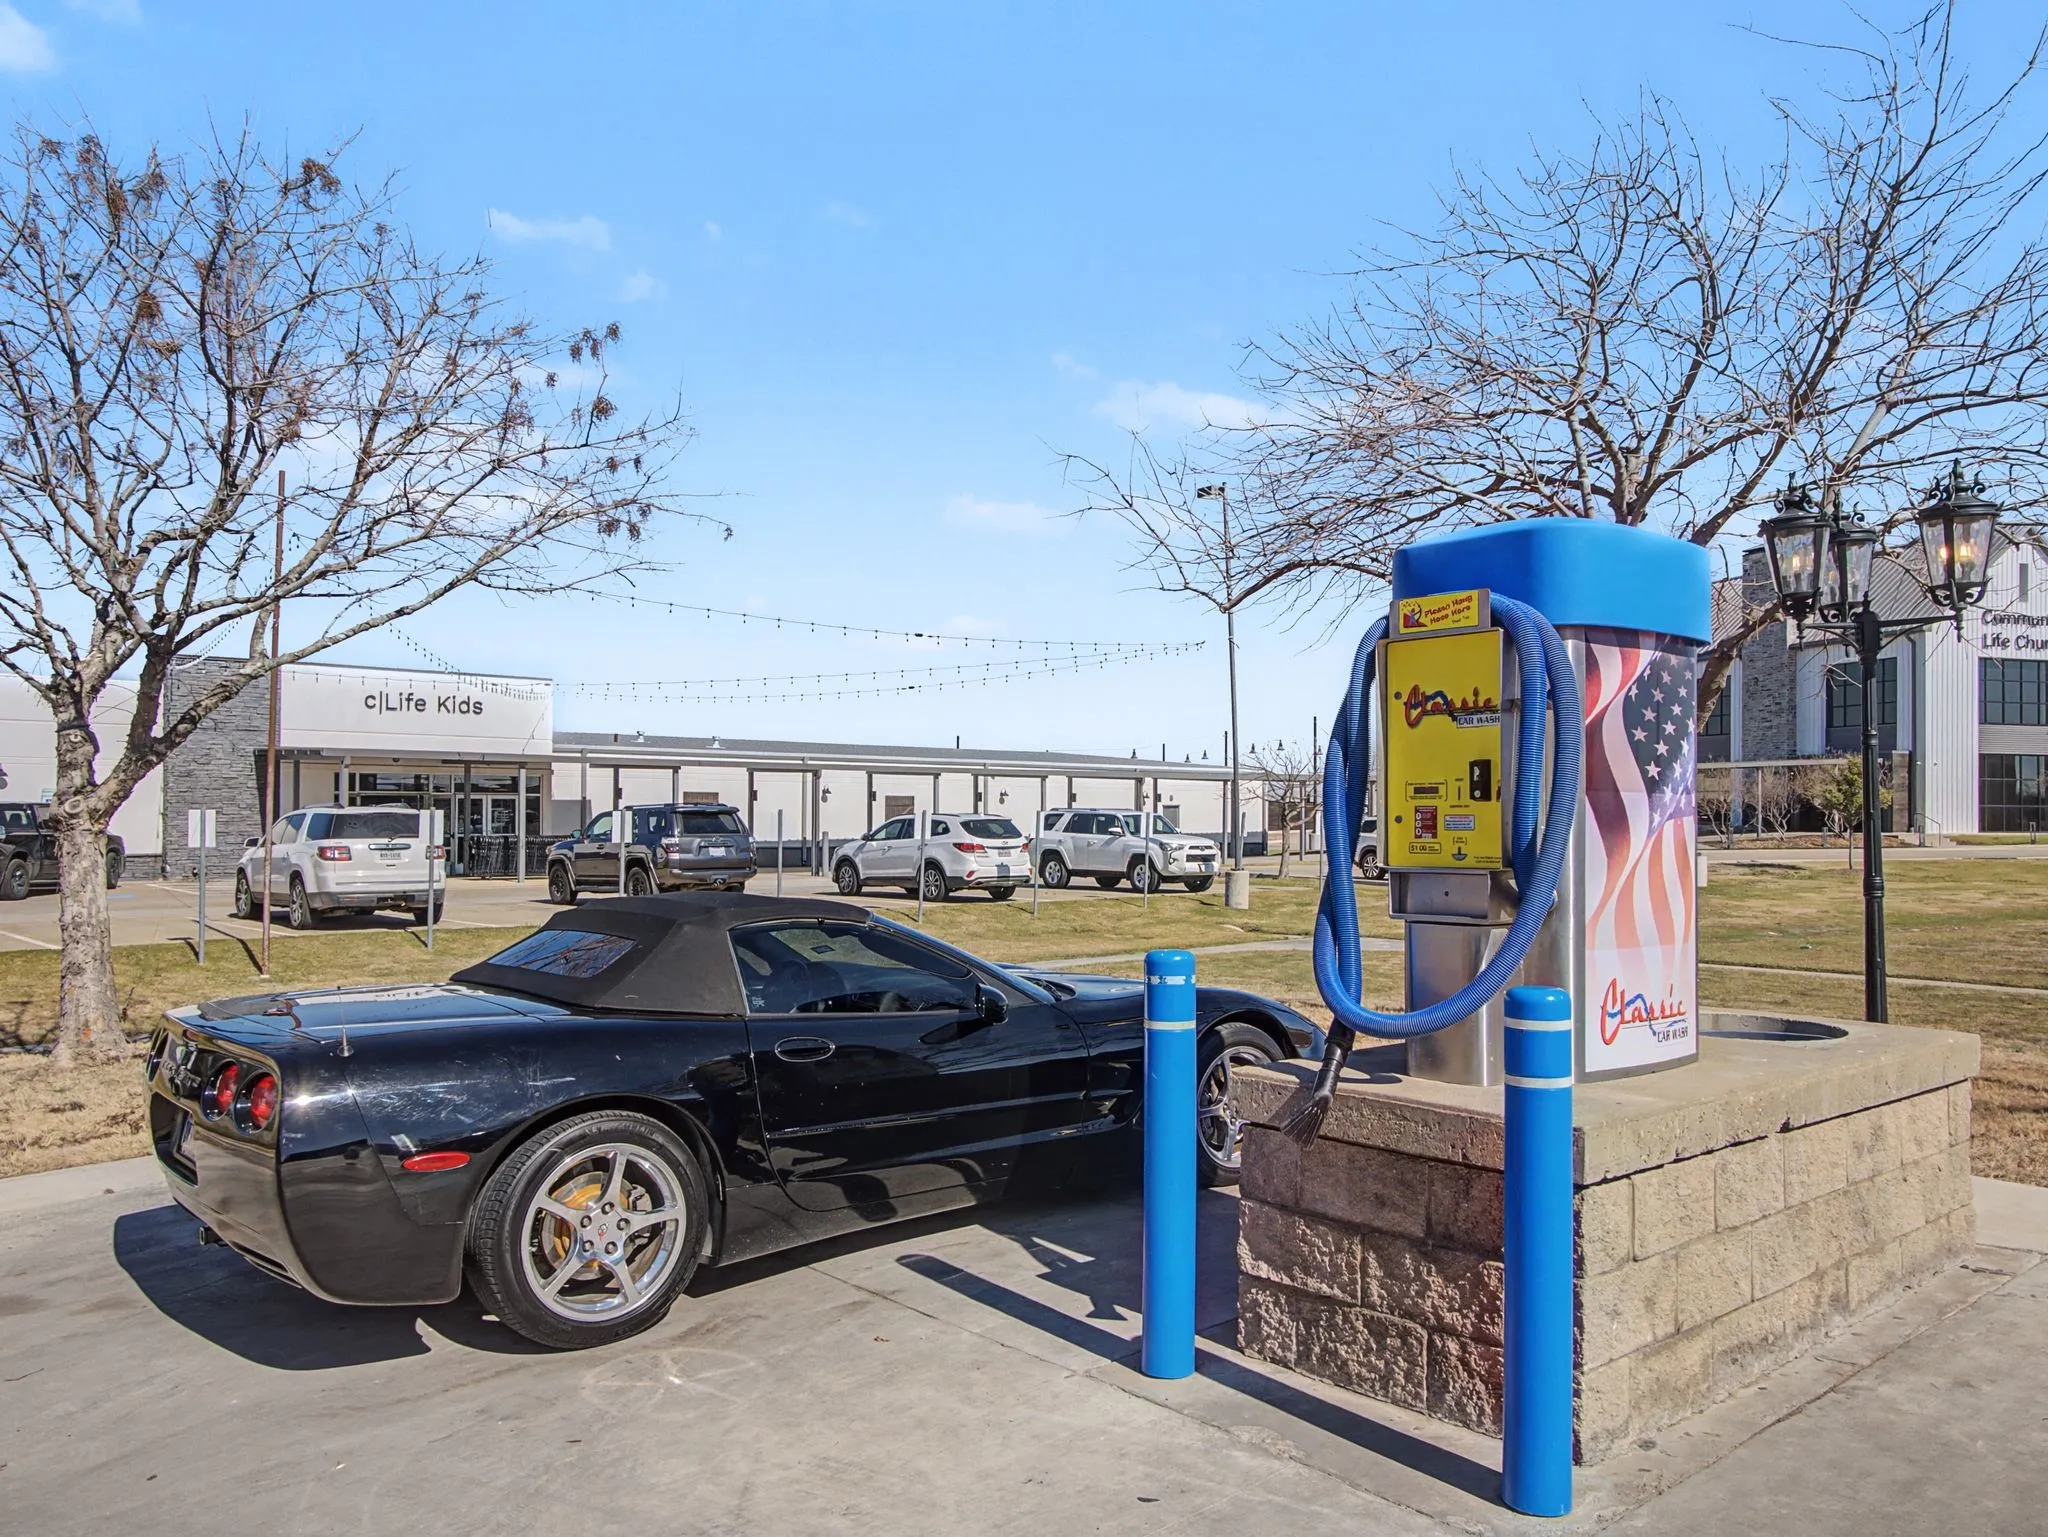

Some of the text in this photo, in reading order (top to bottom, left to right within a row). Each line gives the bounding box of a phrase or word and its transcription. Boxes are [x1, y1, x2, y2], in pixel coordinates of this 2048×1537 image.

[1452, 595, 1473, 607] Hang
[1982, 632, 2011, 650] Life
[437, 695, 484, 715] Kids
[1403, 684, 1498, 729] Classic
[1458, 714, 1500, 726] CAR WASH
[1600, 978, 1687, 1045] Classic
[1657, 1026, 1688, 1043] CAR WASH
